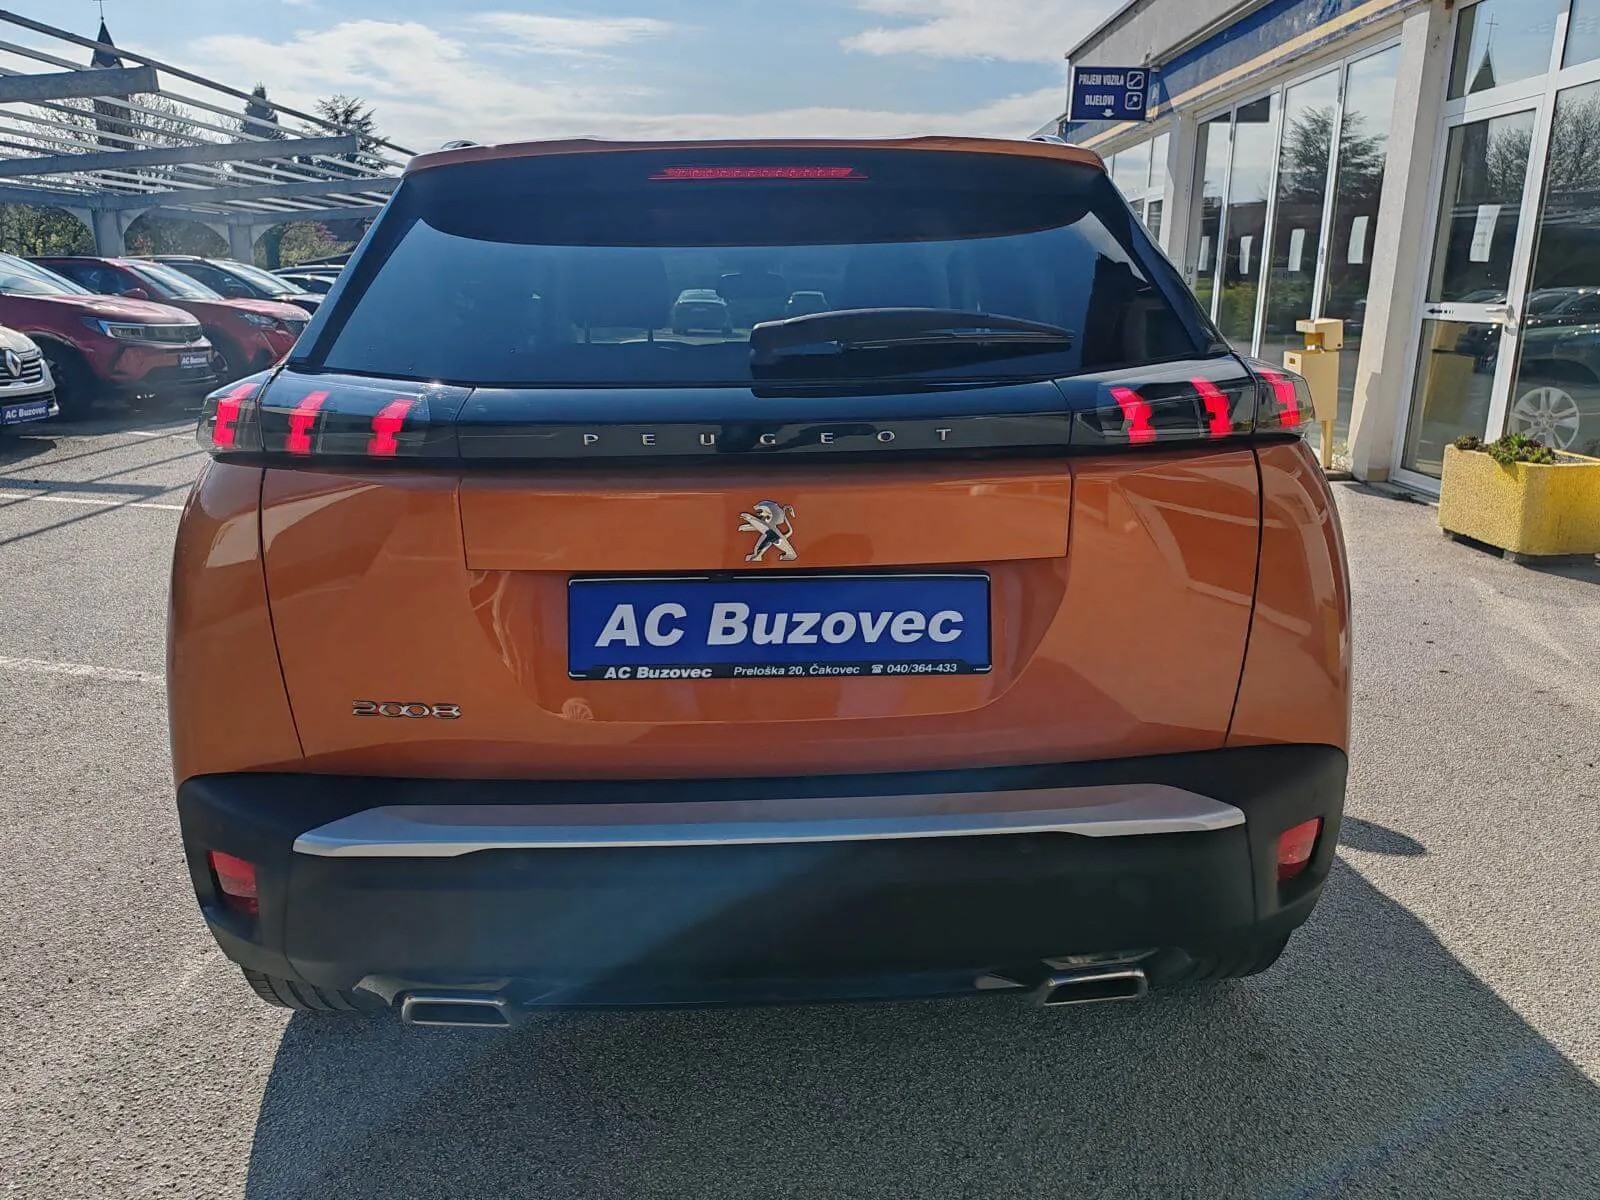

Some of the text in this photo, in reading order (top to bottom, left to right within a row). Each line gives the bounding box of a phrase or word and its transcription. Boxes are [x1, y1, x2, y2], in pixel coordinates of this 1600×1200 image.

[1085, 94, 1114, 106] DIJELOVI
[5, 407, 46, 420] AC Buzovec
[583, 428, 952, 446] PEUGEOT
[595, 602, 964, 648] AC Buzovec
[604, 663, 957, 679] AC Buzovec Preloška 20, Čakovec 040/364-433
[352, 700, 462, 720] 2008
